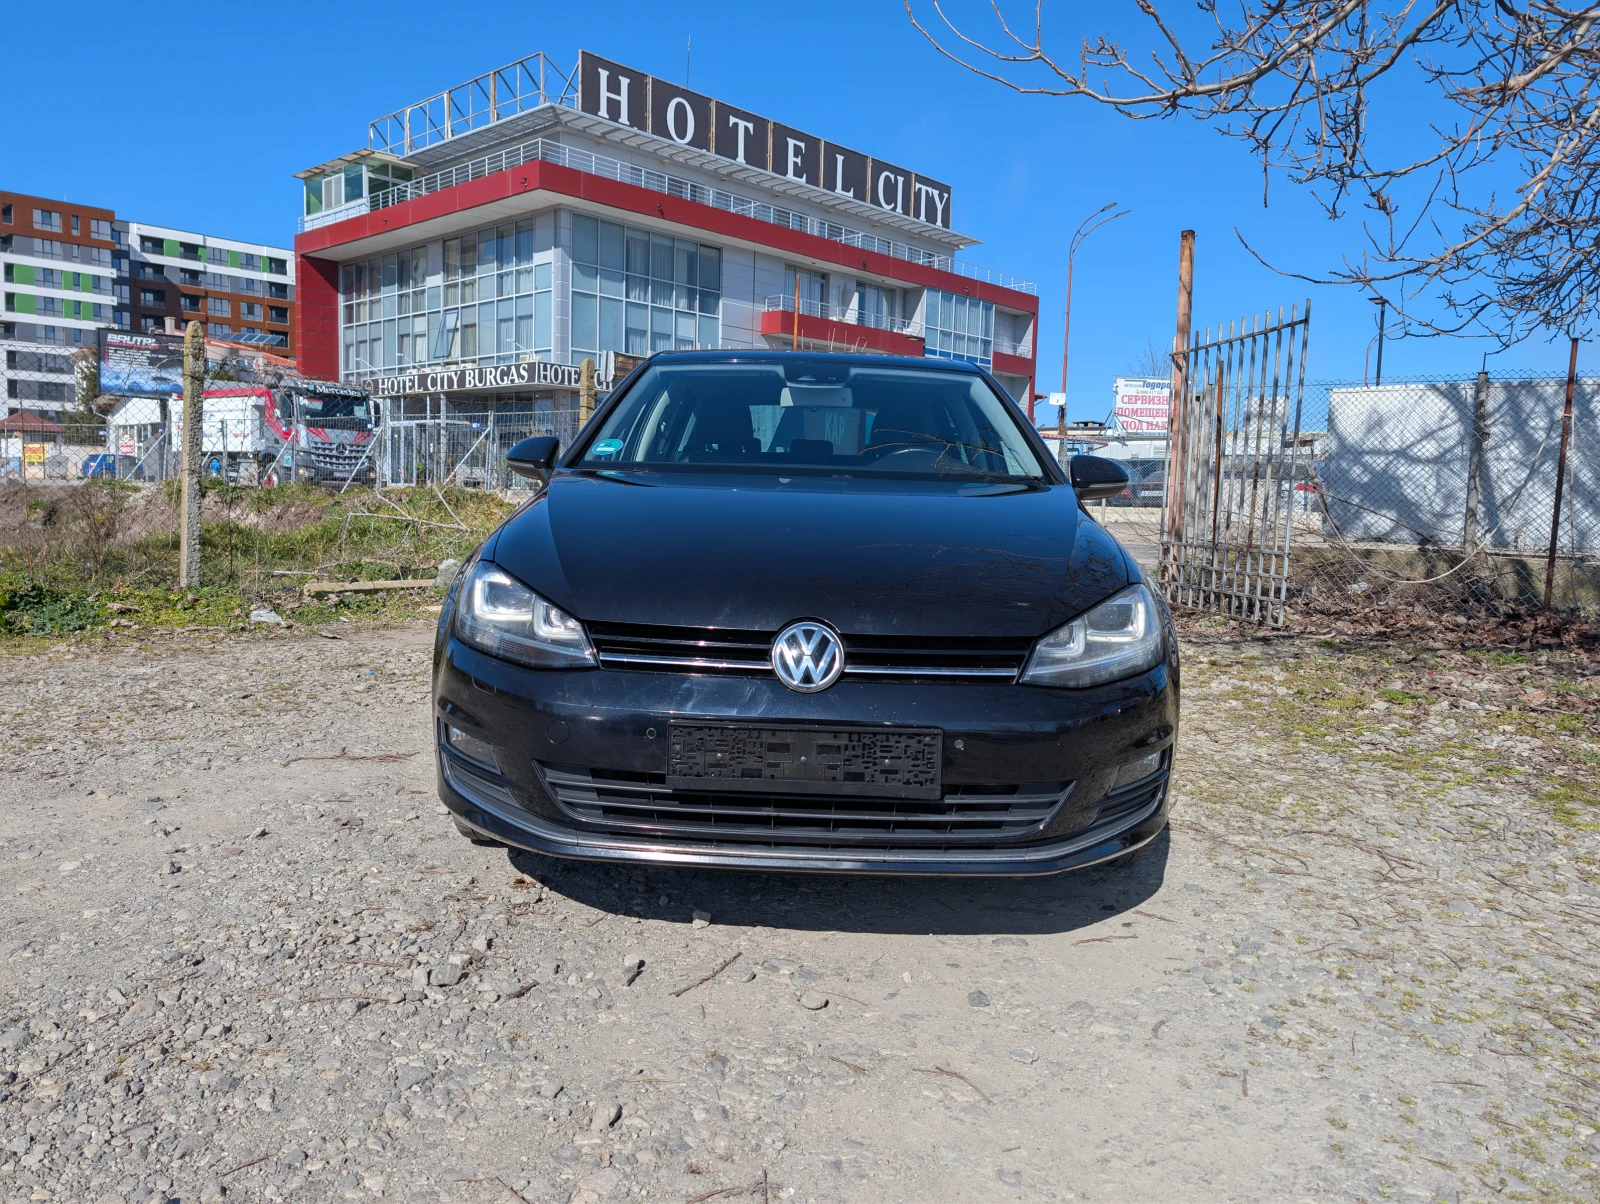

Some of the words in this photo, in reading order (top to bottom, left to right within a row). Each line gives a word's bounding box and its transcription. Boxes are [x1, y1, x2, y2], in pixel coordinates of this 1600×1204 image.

[597, 67, 854, 199] HOTEL
[878, 170, 948, 227] CITY
[378, 375, 424, 396] HOTEL
[427, 370, 461, 391] CITY
[465, 363, 529, 388] BURGAS
[539, 363, 581, 387] HOTE
[316, 385, 362, 397] Mercedes
[1142, 380, 1173, 390] Тодоро
[1121, 394, 1170, 406] СЕРВИЗН
[1117, 407, 1170, 419] ПОМЕЩЕН
[1121, 420, 1143, 433] ПОД
[1146, 420, 1168, 431] НАЕ
